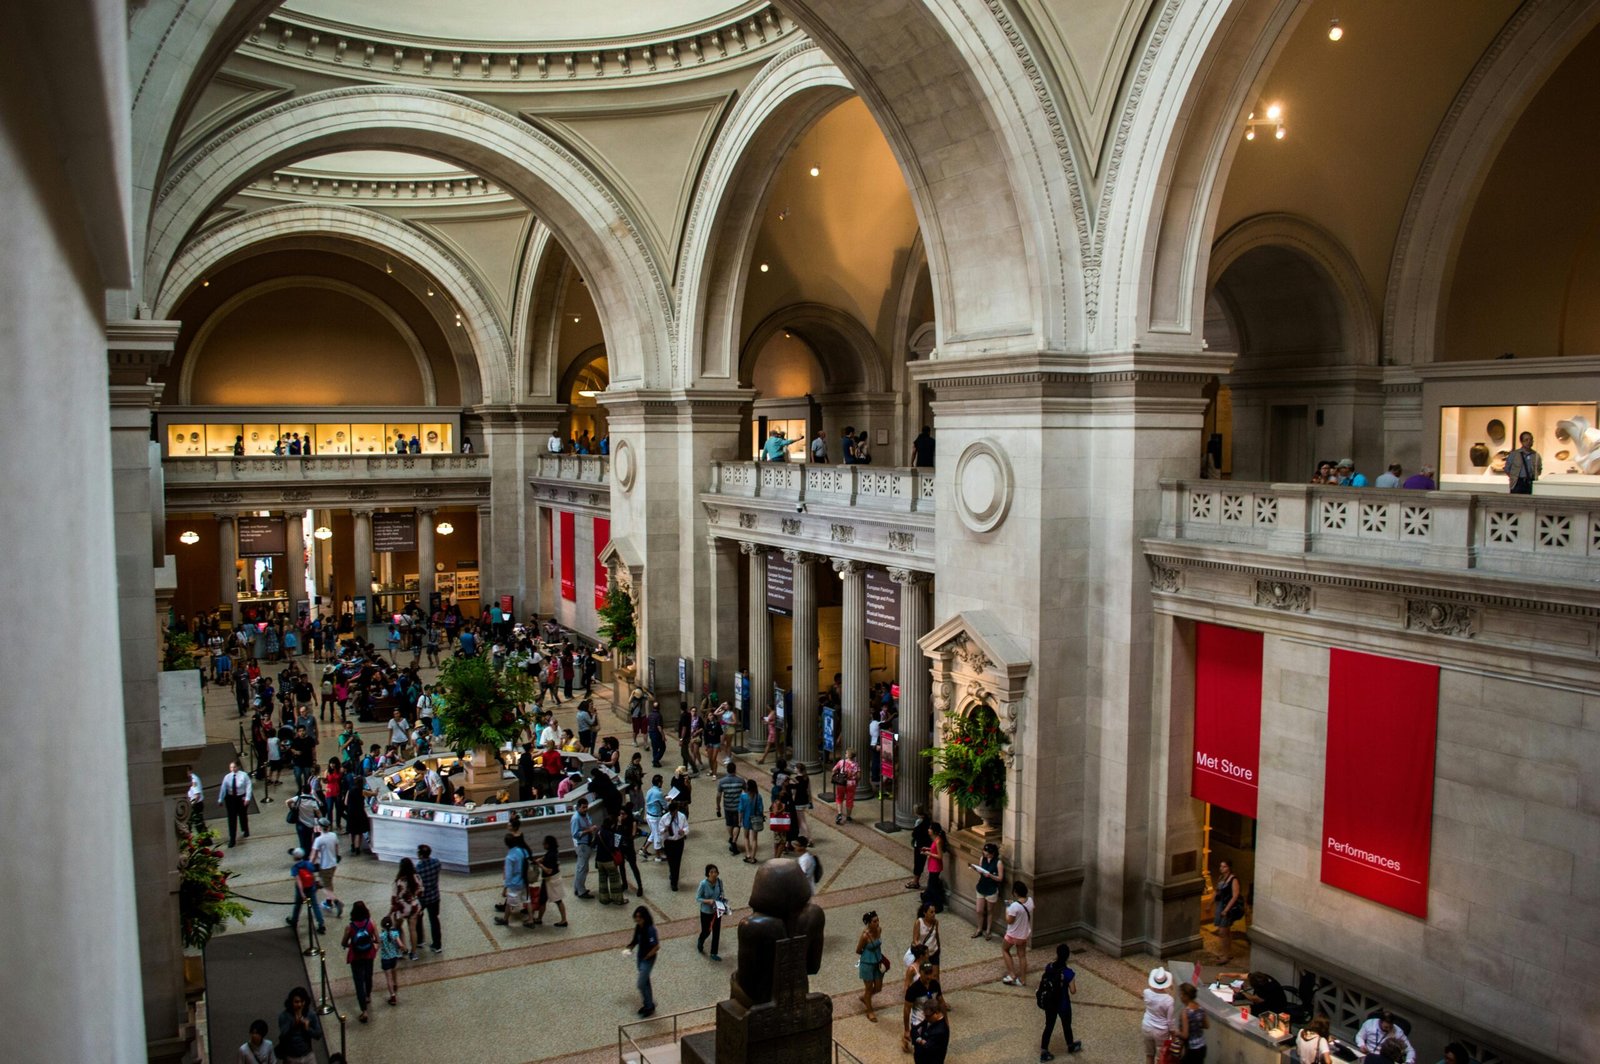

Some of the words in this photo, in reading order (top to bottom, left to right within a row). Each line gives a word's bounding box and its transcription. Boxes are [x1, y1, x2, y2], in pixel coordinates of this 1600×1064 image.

[1196, 751, 1219, 770] Met
[1221, 758, 1253, 781] Store
[1327, 837, 1401, 872] Performances
